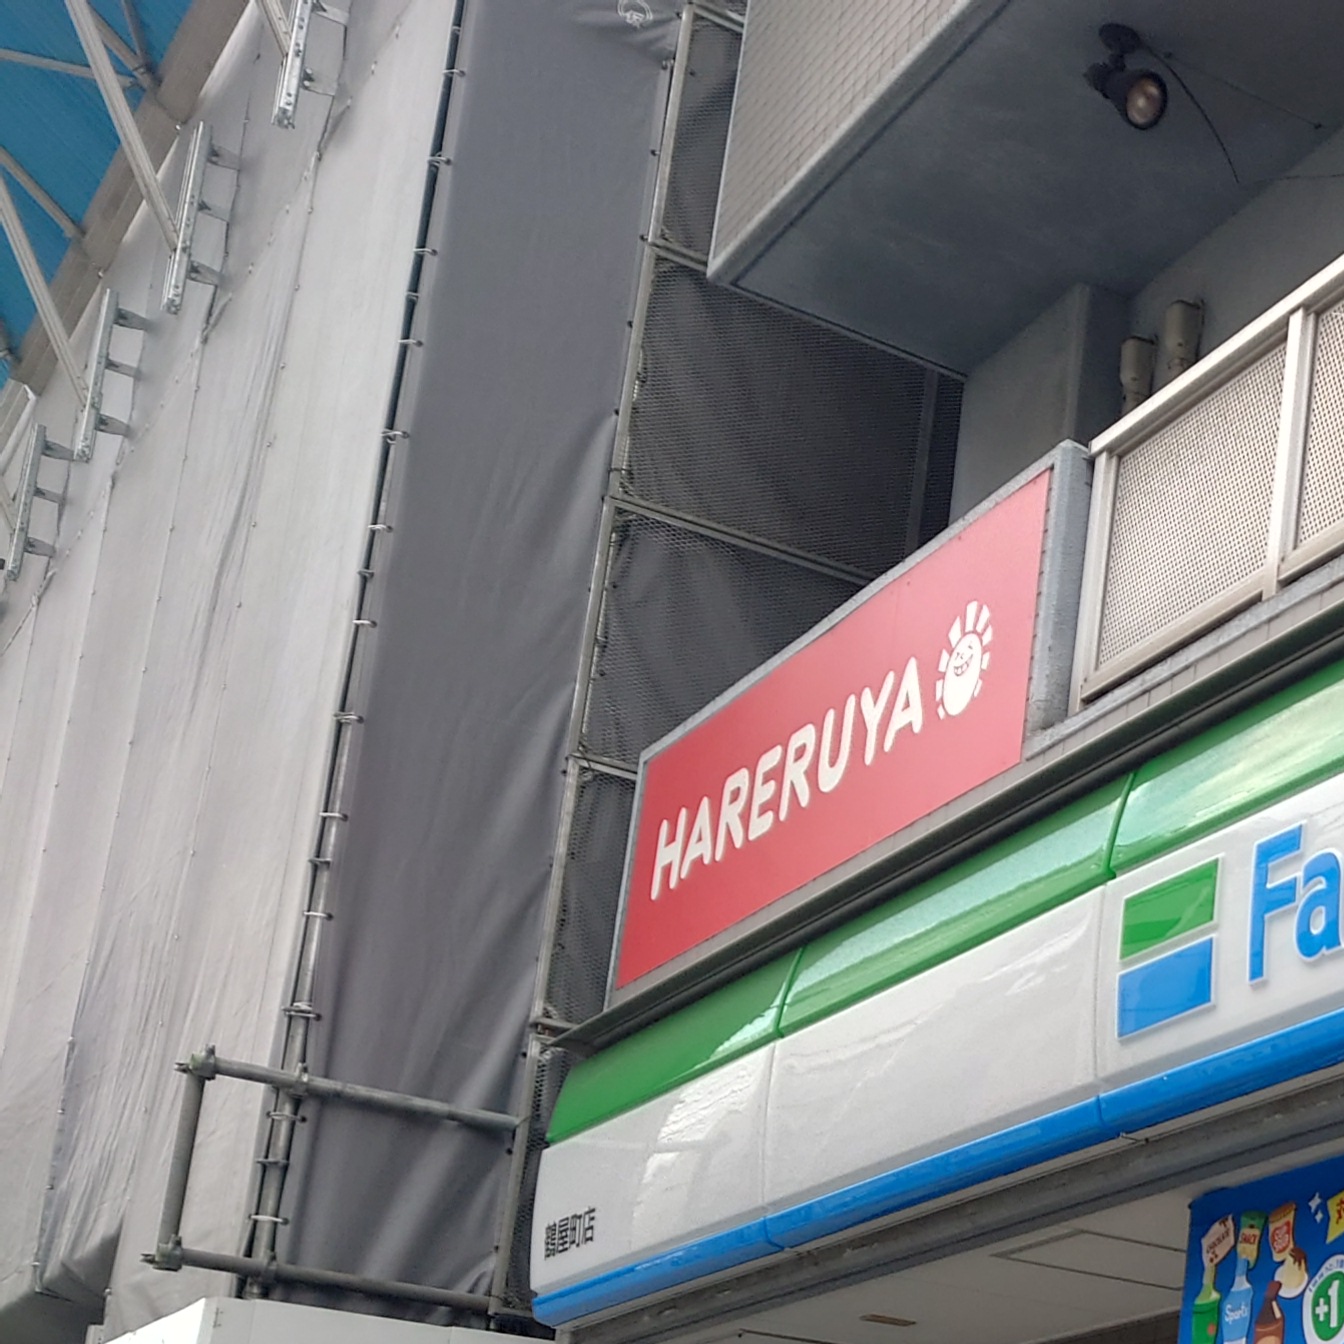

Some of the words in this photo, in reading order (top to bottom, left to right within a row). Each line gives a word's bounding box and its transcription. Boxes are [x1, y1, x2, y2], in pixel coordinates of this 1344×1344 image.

[650, 656, 923, 901] HARERUYA
[544, 1206, 596, 1260] 鶴屋町店
[1225, 1304, 1248, 1324] Sports
[1315, 1280, 1340, 1328] +1
